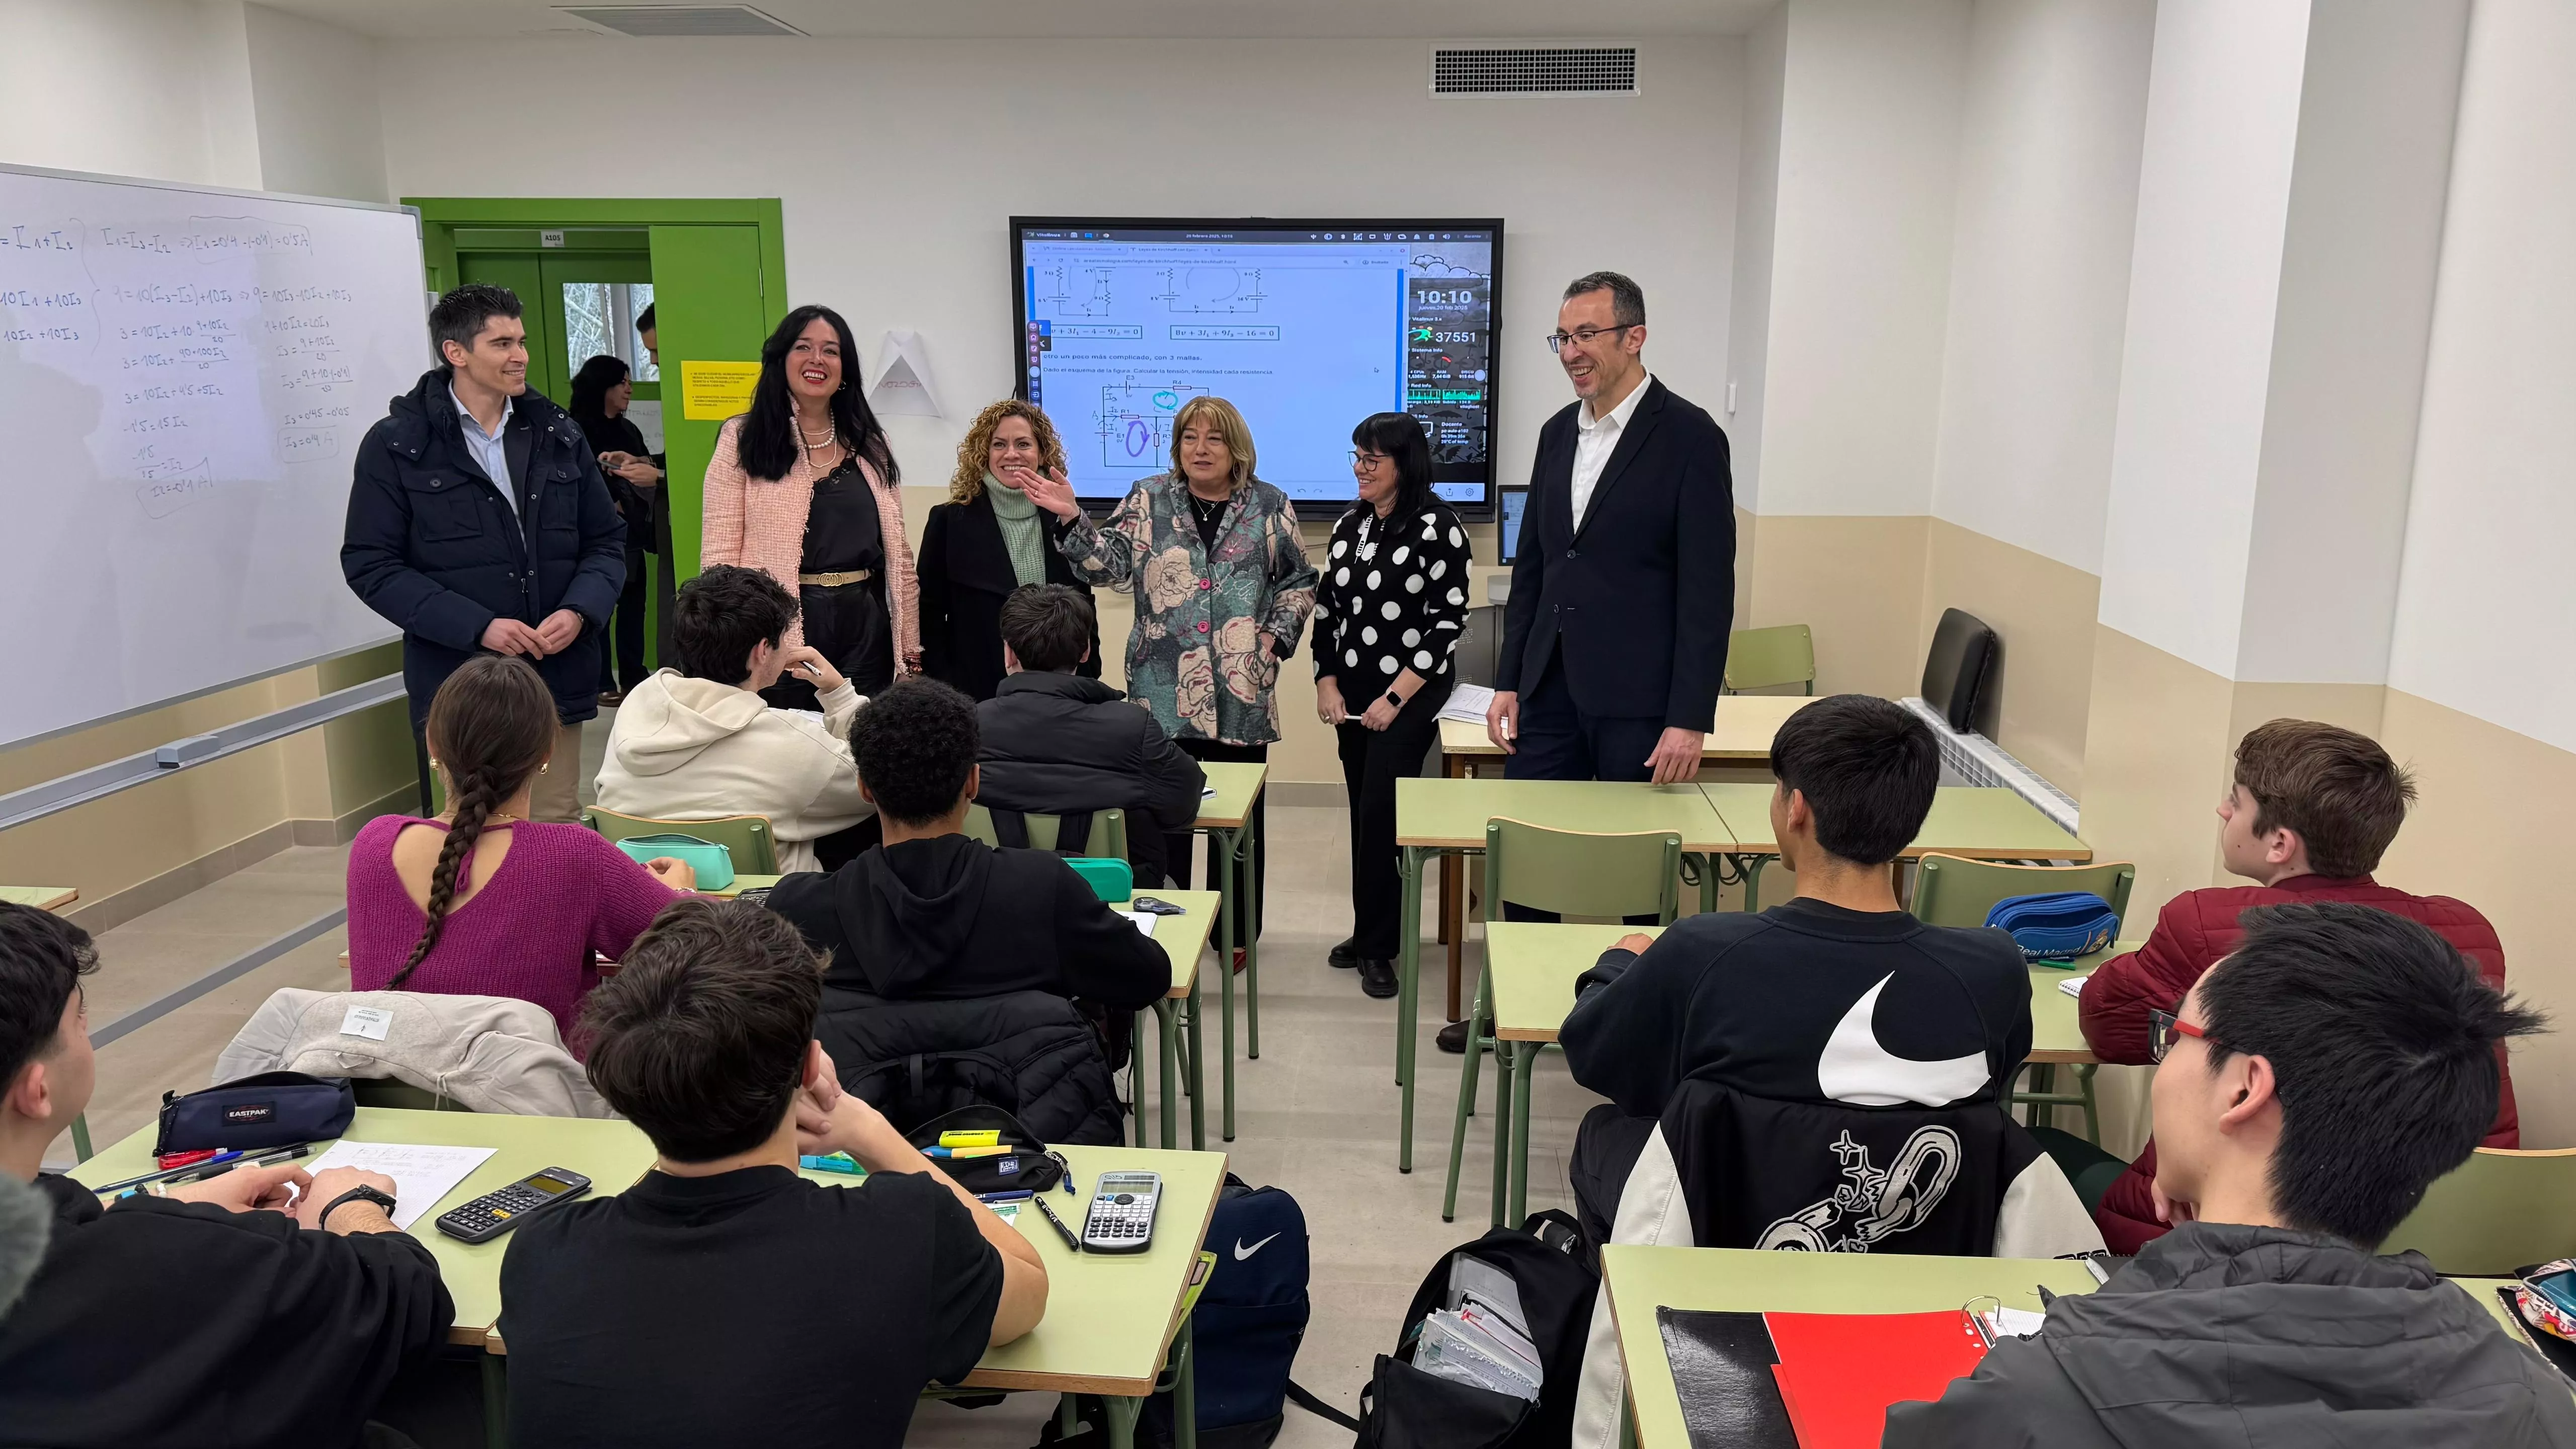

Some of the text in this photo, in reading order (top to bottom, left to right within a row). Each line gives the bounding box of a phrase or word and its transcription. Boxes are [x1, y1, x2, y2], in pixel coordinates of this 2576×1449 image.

[1417, 290, 1472, 304] 10:10
[1435, 332, 1476, 343] 37551
[2017, 944, 2042, 956] Real
[229, 1109, 267, 1117] EASTPAK
